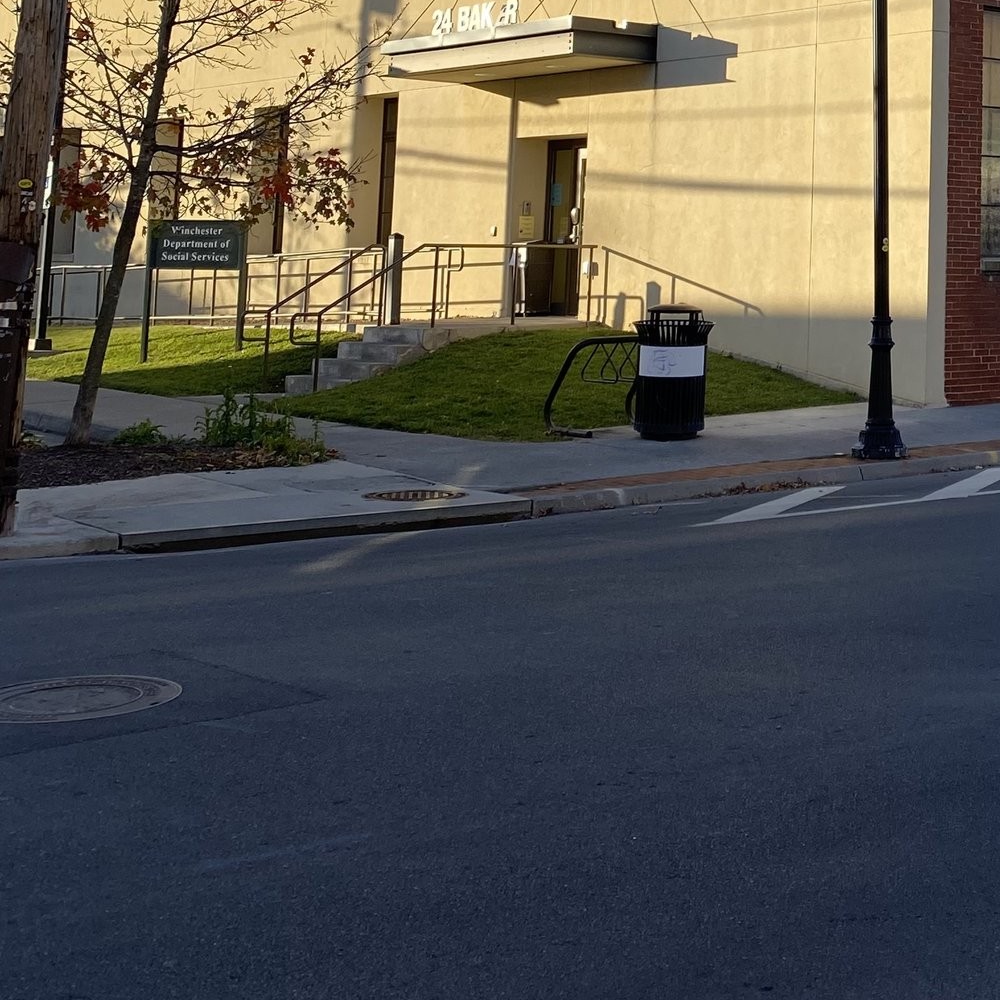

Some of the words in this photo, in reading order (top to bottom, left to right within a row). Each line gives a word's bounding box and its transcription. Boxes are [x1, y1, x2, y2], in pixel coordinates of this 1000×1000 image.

[431, 7, 453, 36] 24
[171, 226, 223, 235] Winchester
[163, 239, 218, 250] Department
[220, 239, 231, 248] of
[161, 251, 189, 261] Social
[191, 252, 229, 262] Services
